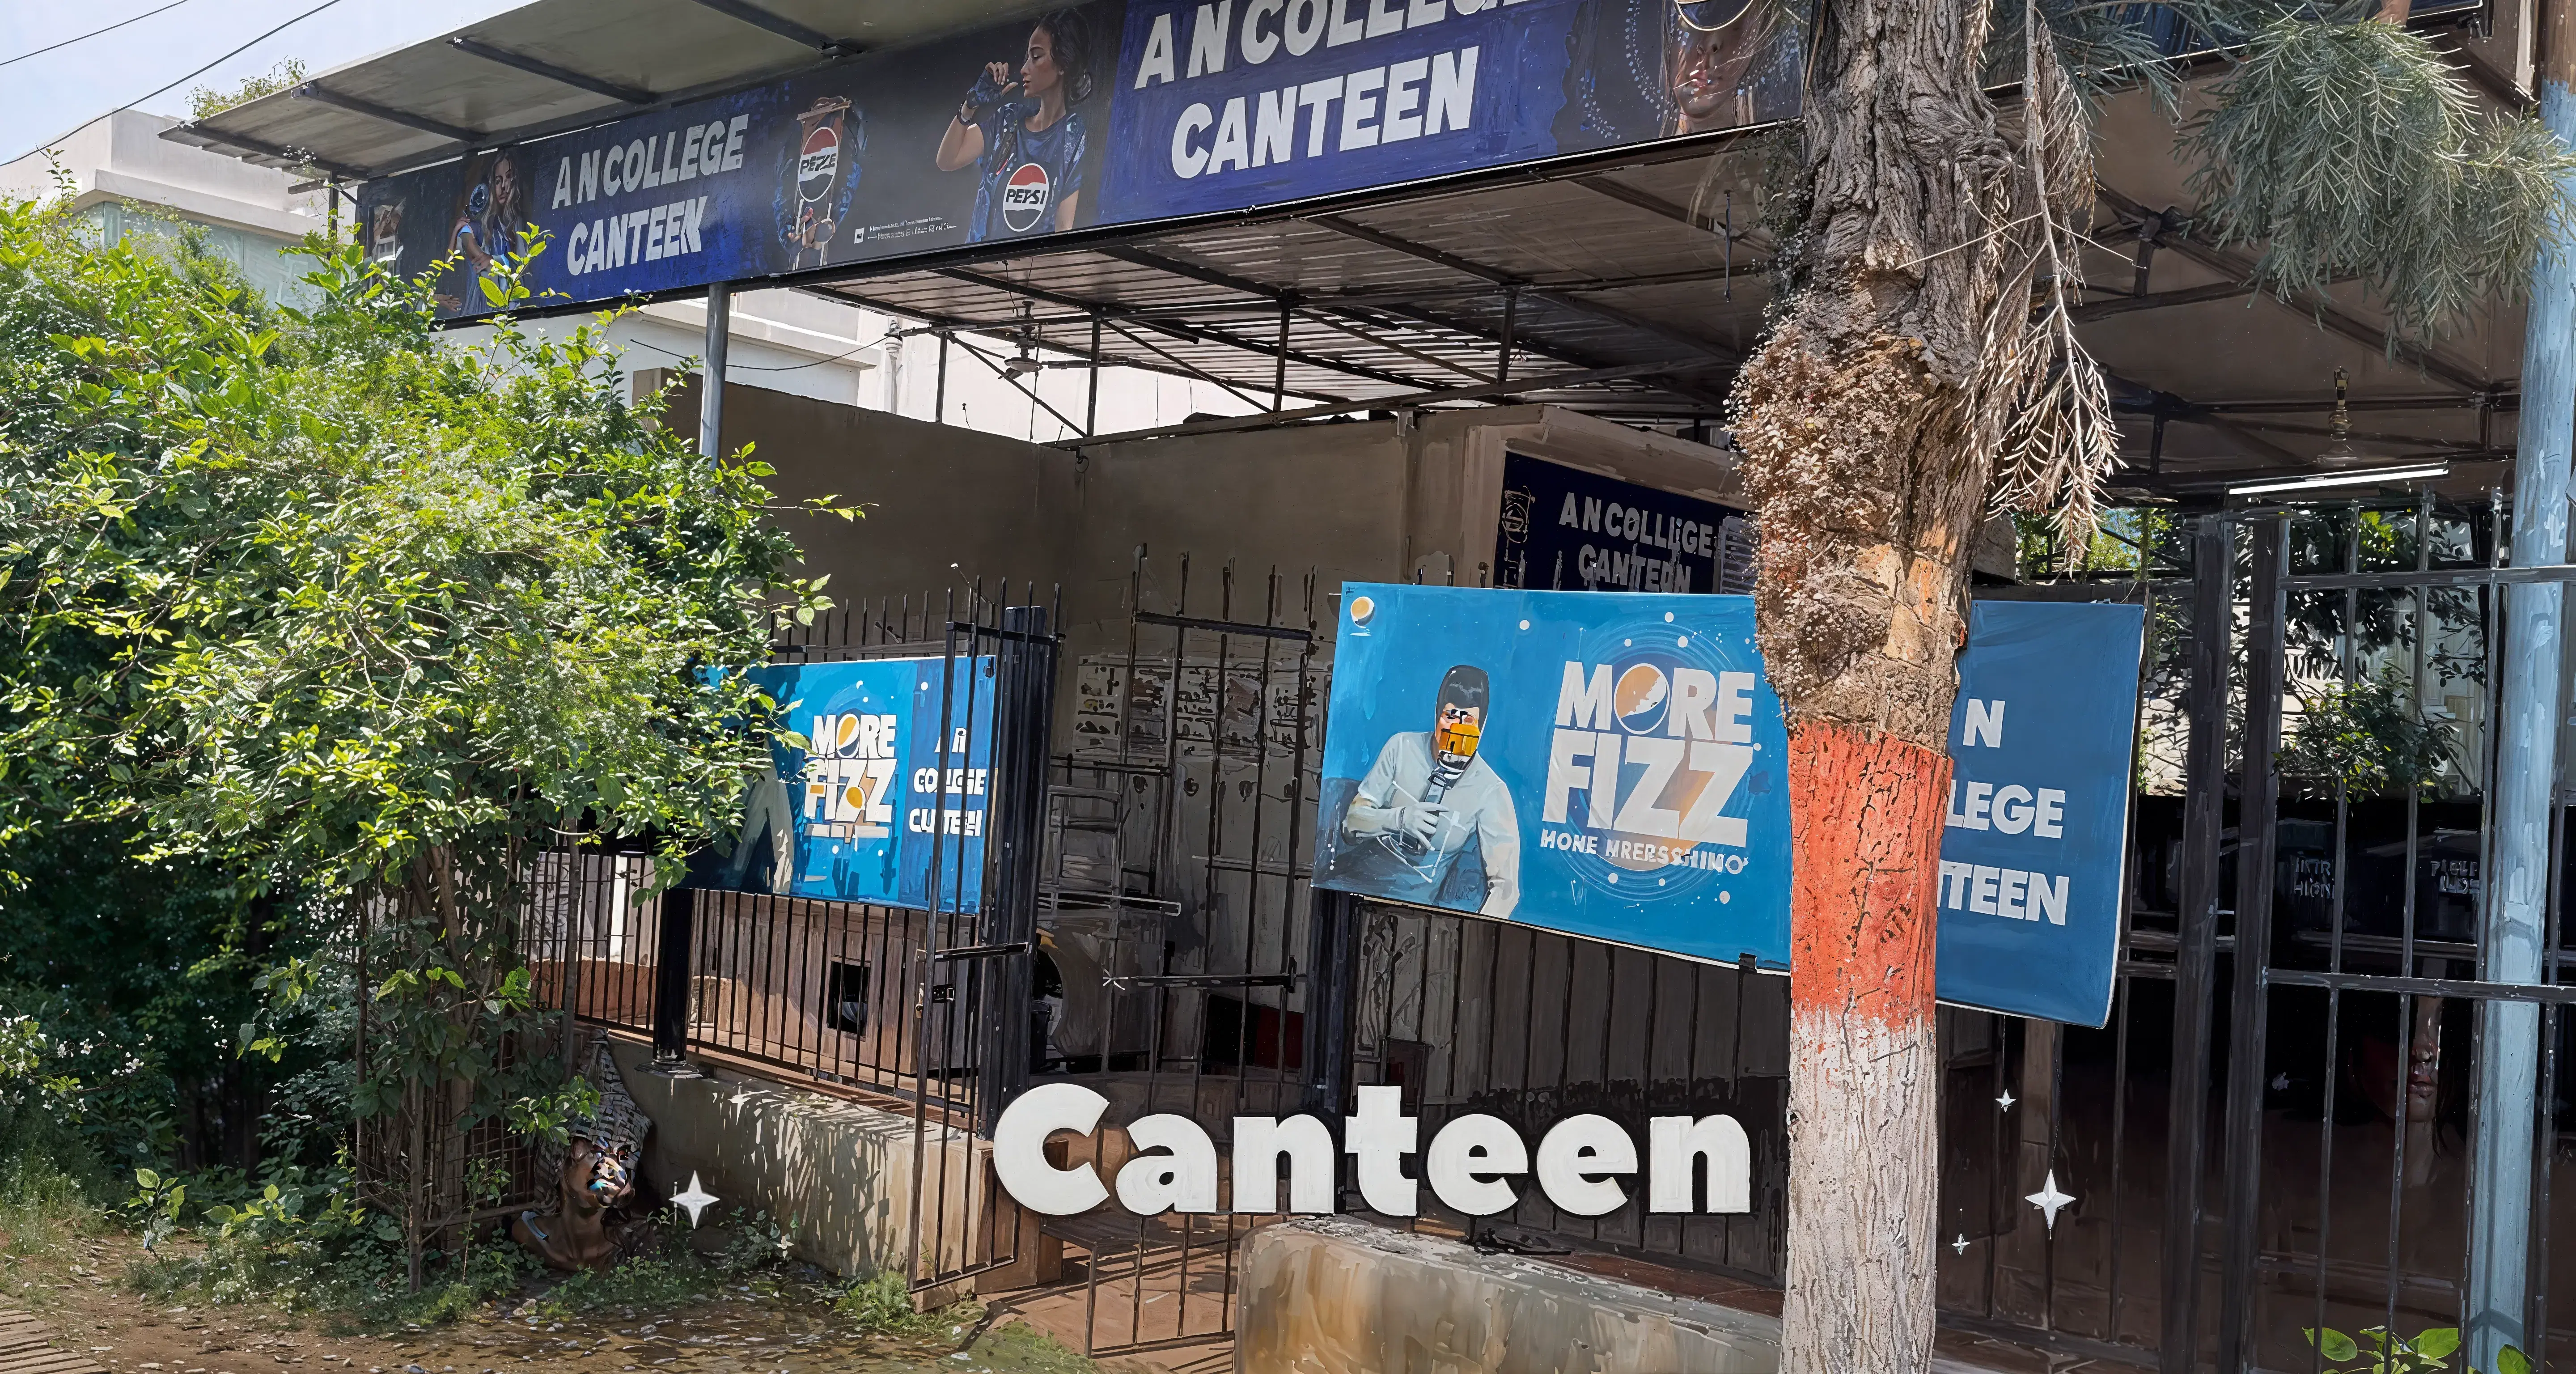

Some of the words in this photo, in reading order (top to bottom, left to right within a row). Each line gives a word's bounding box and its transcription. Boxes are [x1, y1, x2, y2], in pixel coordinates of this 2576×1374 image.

[1241, 0, 1529, 64] COLL
[1172, 46, 1479, 179] CANTEEN
[603, 114, 749, 197] COLLEGE
[812, 713, 896, 759] MORE
[1555, 661, 1755, 743] MORE
[1542, 728, 1753, 847] FIZZ
[1937, 859, 2069, 926] TEEN
